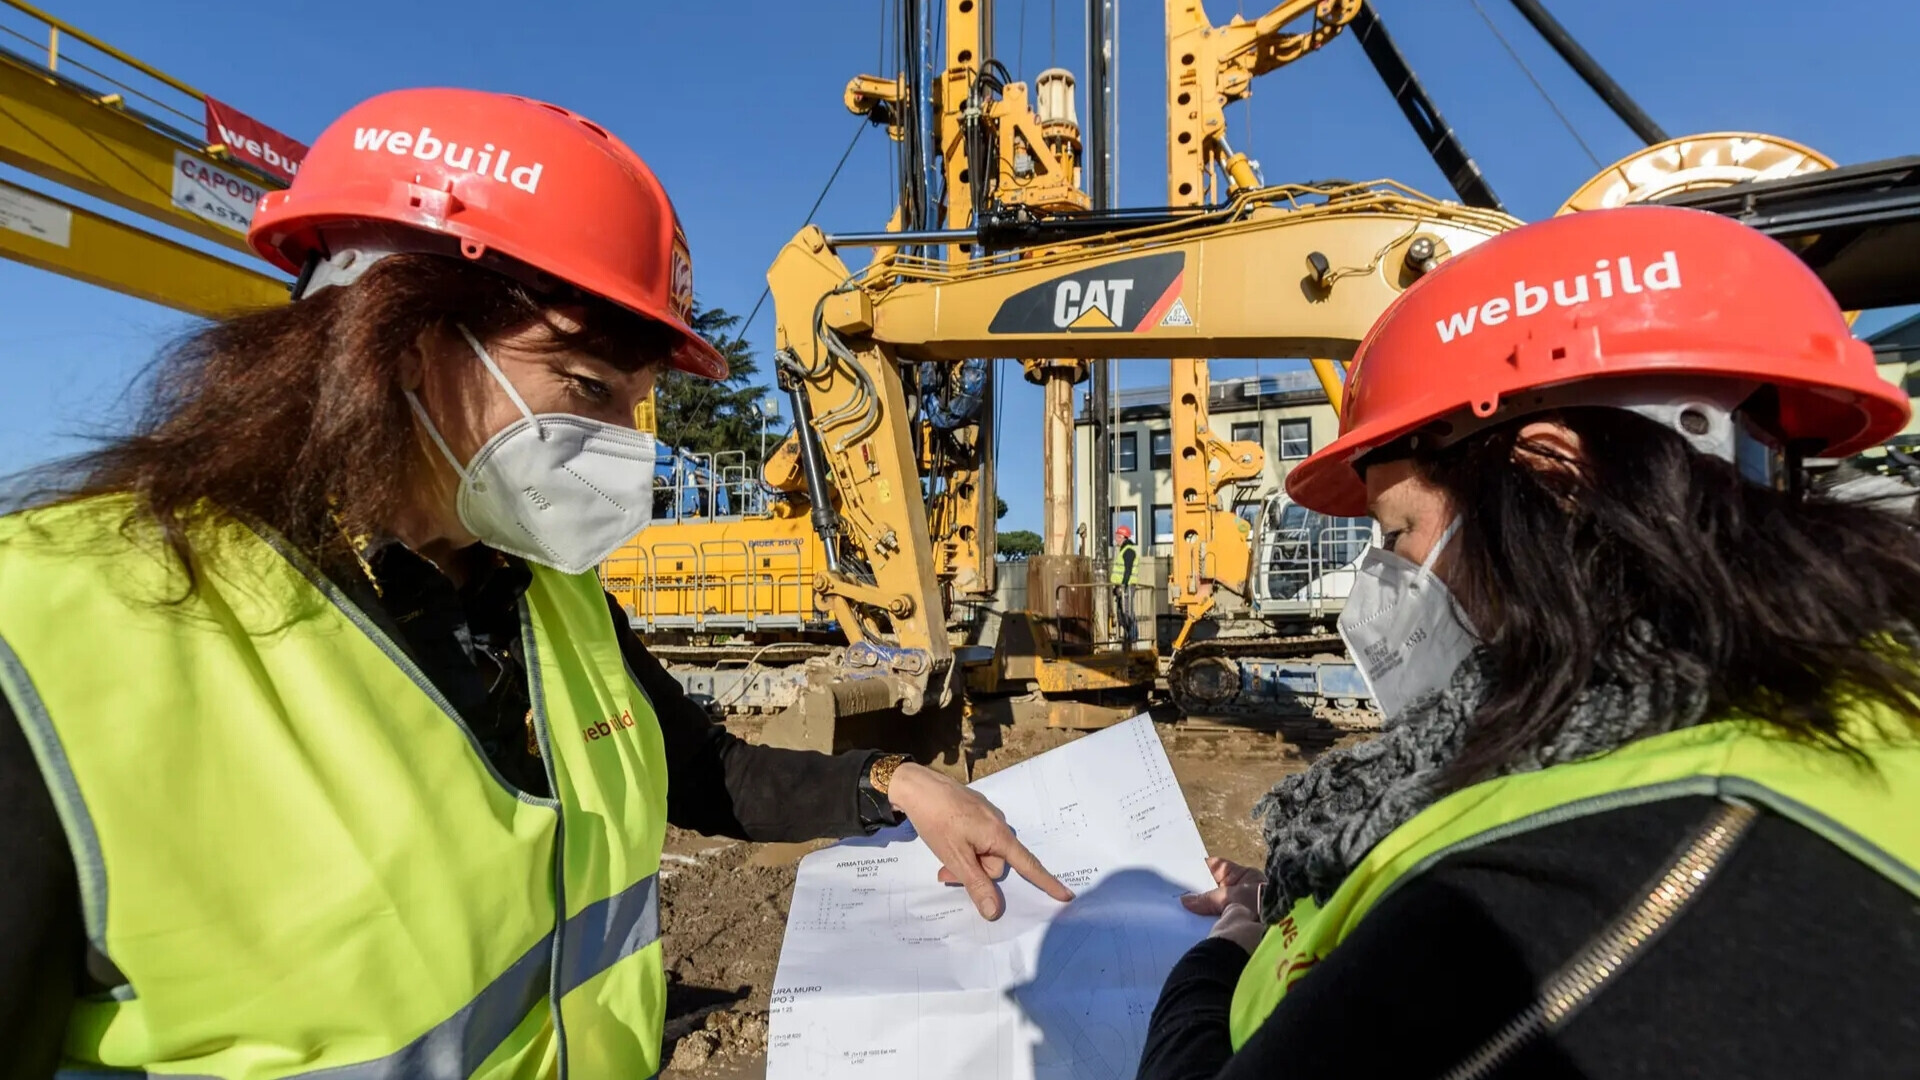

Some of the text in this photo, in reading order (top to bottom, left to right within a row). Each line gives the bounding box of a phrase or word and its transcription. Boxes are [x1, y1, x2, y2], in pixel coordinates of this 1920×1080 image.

[218, 123, 302, 176] webu
[353, 127, 544, 195] webuild
[204, 202, 251, 227] ASTA
[1053, 279, 1134, 328] CAT
[1435, 251, 1682, 344] webuild
[523, 486, 552, 511] KN95
[1404, 628, 1427, 650] KN95
[837, 856, 899, 868] ARMATURA MURO
[1076, 868, 1092, 876] TIPO
[789, 995, 795, 1003] 3
